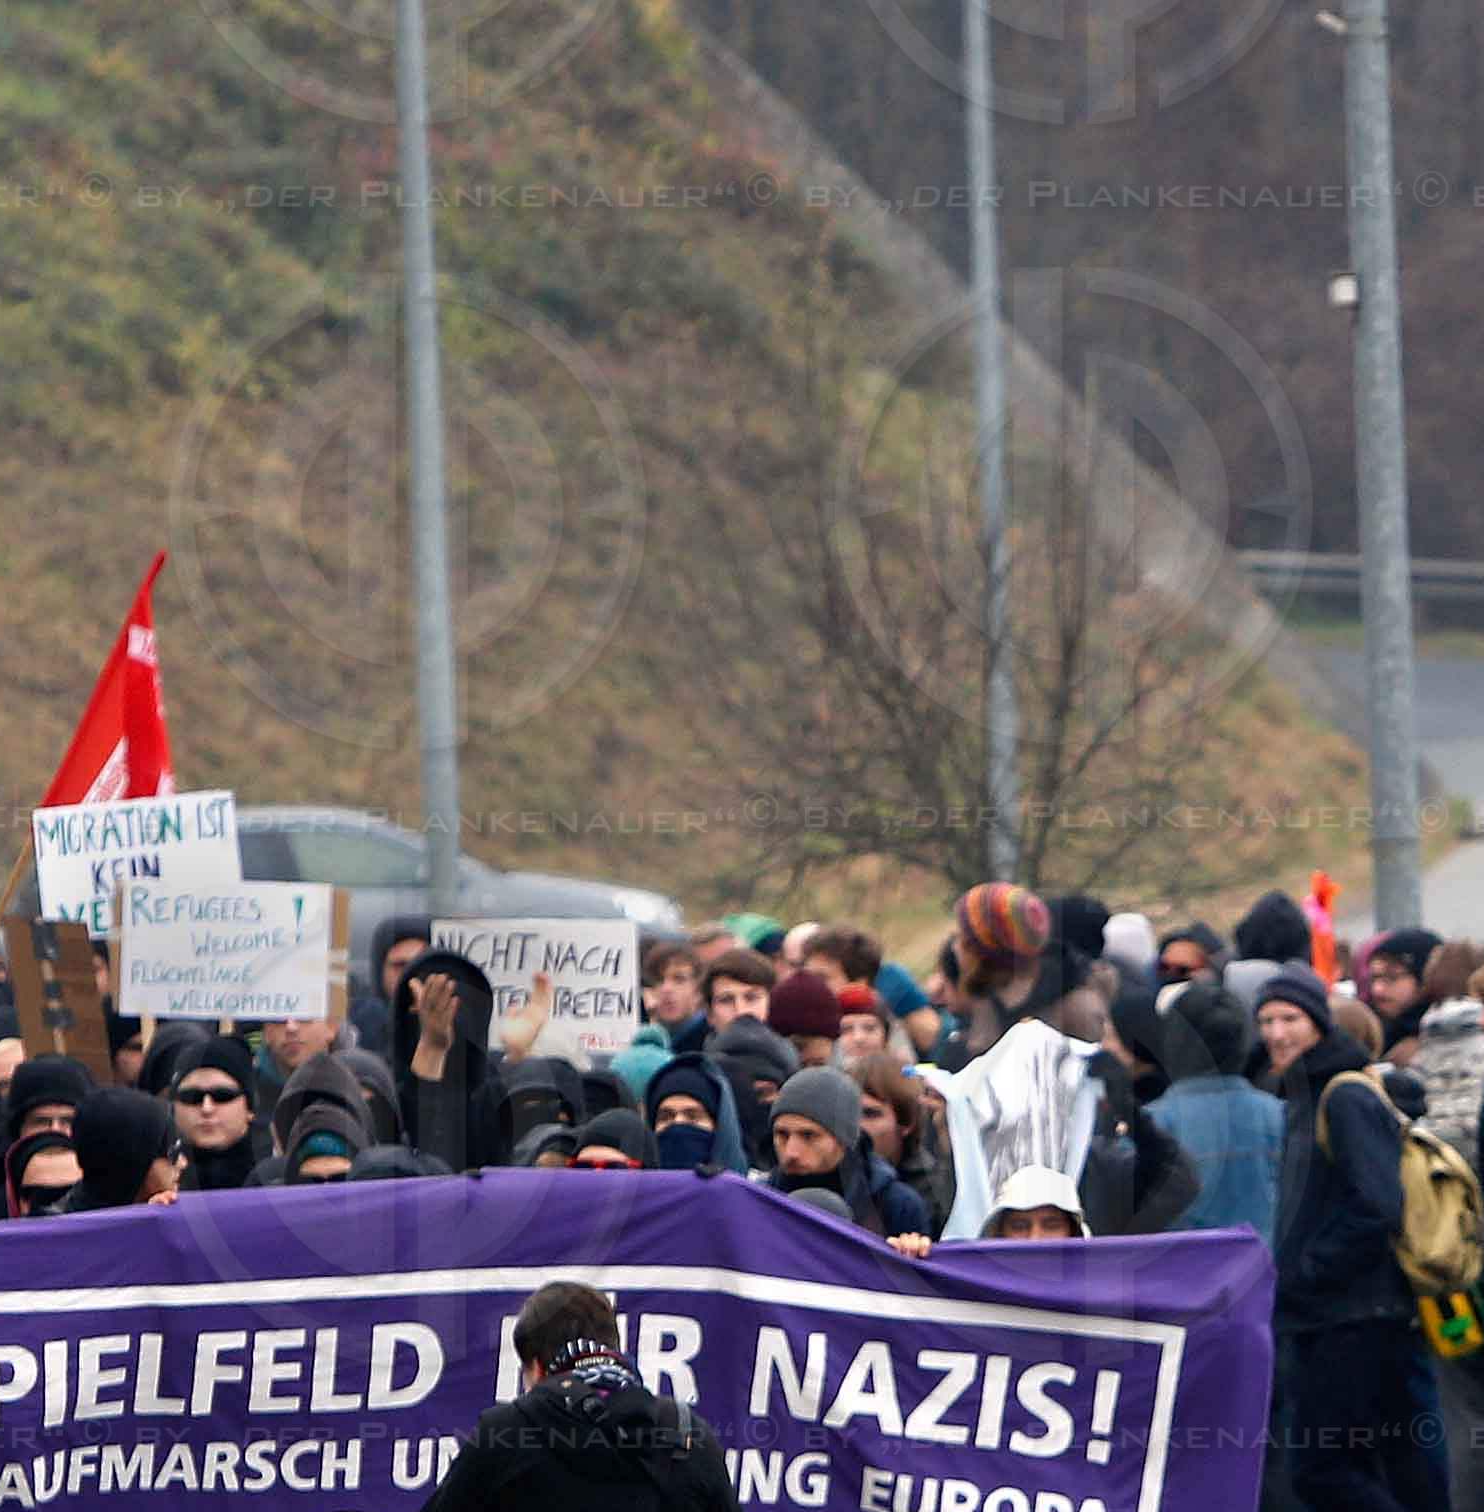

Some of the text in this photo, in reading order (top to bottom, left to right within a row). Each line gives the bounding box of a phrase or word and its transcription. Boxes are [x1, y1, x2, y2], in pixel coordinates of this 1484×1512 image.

[36, 797, 230, 858] MIGRATION IST
[91, 852, 161, 895] KEIN
[131, 883, 261, 927] REFUGEES
[542, 940, 623, 976] NACH
[748, 1325, 1122, 1466] NAZIS!
